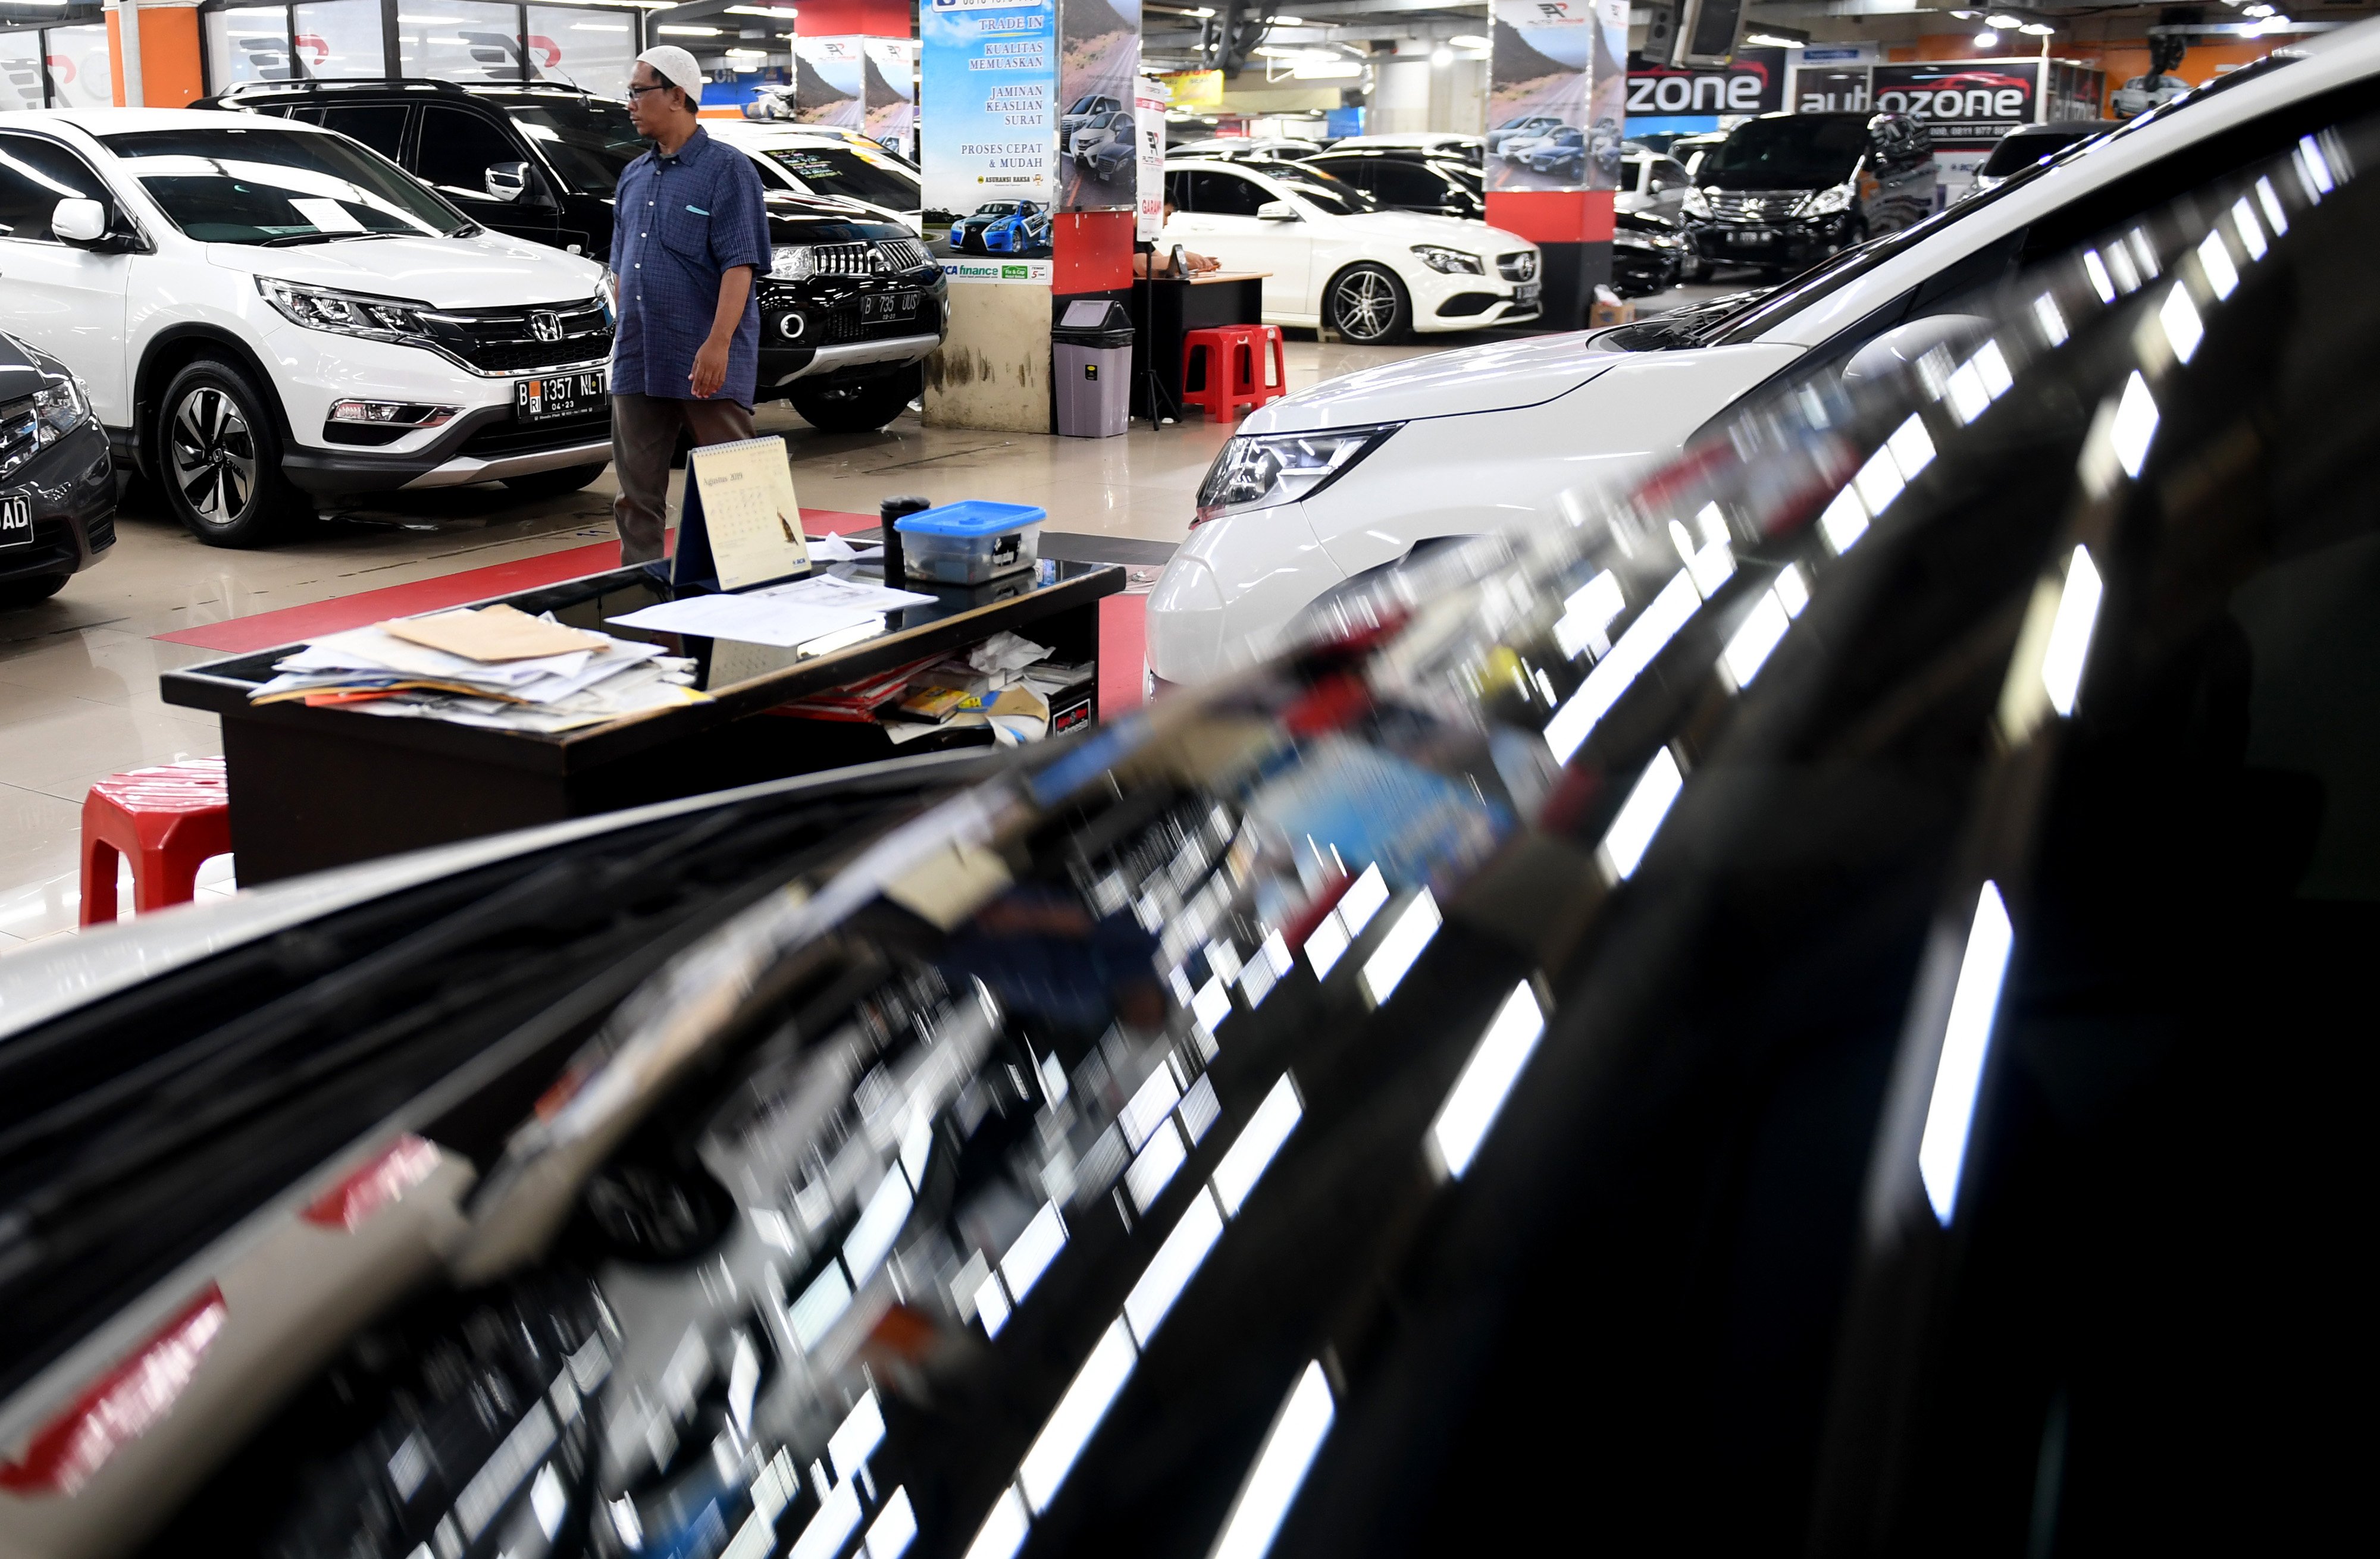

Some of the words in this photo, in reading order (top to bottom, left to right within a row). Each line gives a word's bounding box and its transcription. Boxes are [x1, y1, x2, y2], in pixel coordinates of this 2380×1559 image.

[979, 18, 1025, 30] TRADE
[1029, 17, 1044, 28] IN
[985, 42, 1043, 55] KUALITAS
[970, 57, 1043, 70] MEMUASKAN
[990, 86, 1043, 100] JAMINAN
[986, 100, 1043, 111] KEASLIAN
[1004, 115, 1043, 125] SURAT
[961, 144, 1003, 155] PROSES
[1006, 143, 1043, 153] CEPAT
[989, 159, 996, 168] &
[1000, 158, 1042, 168] MUDAH
[942, 265, 958, 275] CA
[959, 265, 998, 275] finance
[865, 297, 872, 314] B
[879, 295, 895, 313] 735
[519, 384, 528, 406] B
[543, 377, 572, 402] 1357
[580, 372, 603, 396] NLT
[531, 397, 540, 412] RI
[703, 476, 728, 487] Agustus
[730, 472, 743, 481] 2019
[0, 500, 29, 530] AD
